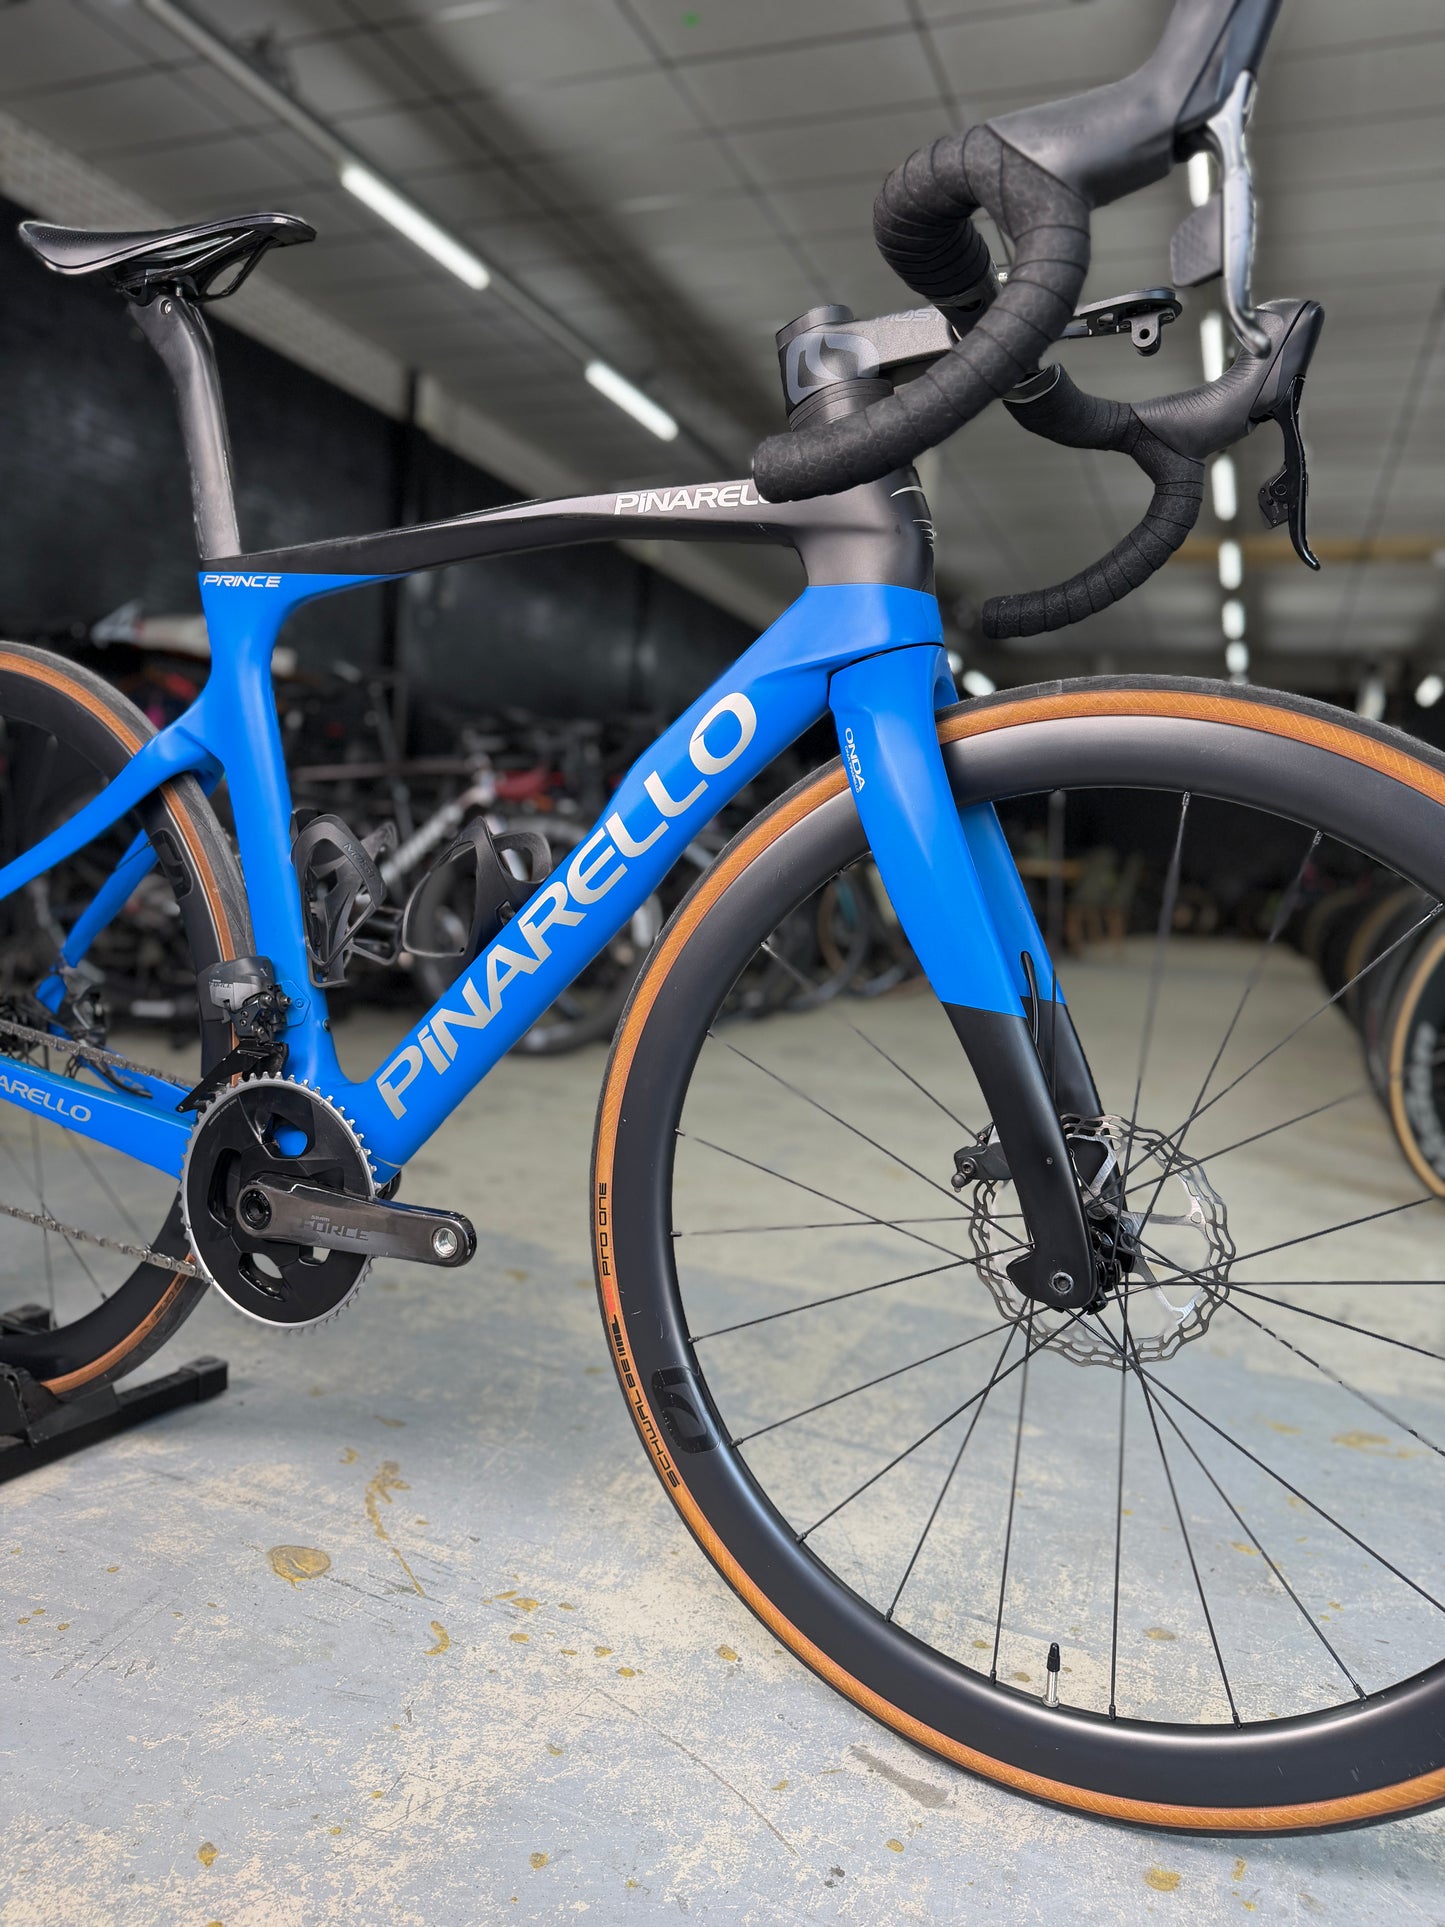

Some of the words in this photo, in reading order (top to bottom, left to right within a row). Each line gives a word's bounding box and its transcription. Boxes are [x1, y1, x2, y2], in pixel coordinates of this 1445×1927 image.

[614, 485, 772, 515] PINAREL
[203, 574, 282, 588] PRINCE
[845, 728, 865, 791] ONDA
[299, 1218, 369, 1241] FORCE
[620, 1358, 681, 1489] SCHWALBE
